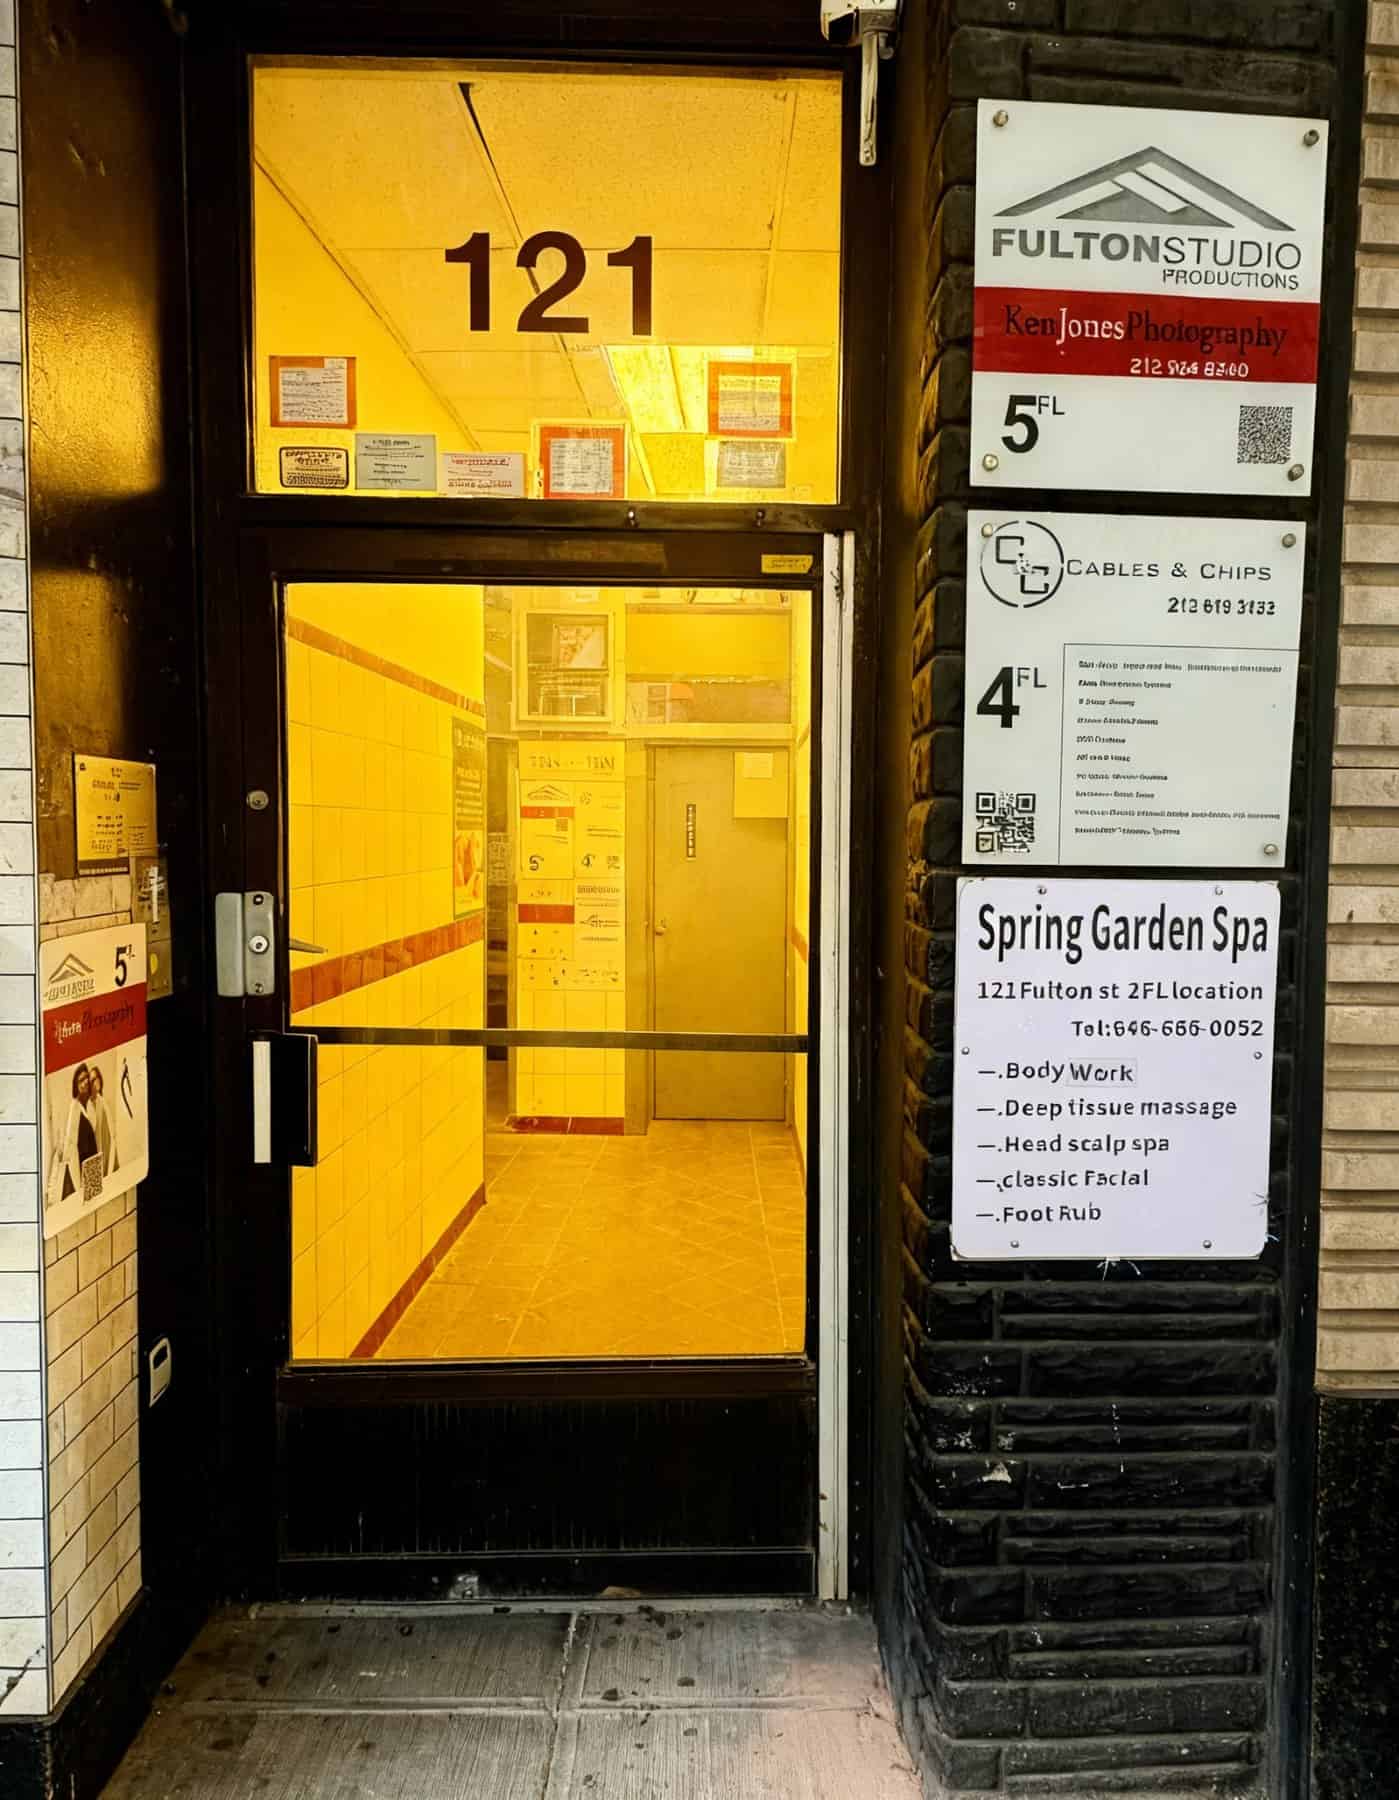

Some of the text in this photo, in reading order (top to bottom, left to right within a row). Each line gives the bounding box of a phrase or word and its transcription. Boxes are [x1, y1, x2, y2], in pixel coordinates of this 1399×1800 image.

[444, 231, 653, 337] 121
[1162, 268, 1299, 291] PRODUCTIONS
[1129, 358, 1163, 376] 212
[1066, 559, 1272, 582] CABLES & CHIPS
[1167, 596, 1198, 614] 212
[977, 902, 1268, 965] Spring Garden Spa
[1099, 983, 1120, 1000] st
[1069, 1062, 1134, 1082] Work
[1067, 1097, 1135, 1117] tissue
[1140, 1101, 1238, 1120] massage
[1067, 1133, 1126, 1157] scalp
[1131, 1138, 1170, 1157] spa
[1084, 1168, 1149, 1188] Facial
[1059, 1201, 1102, 1222] Rub
